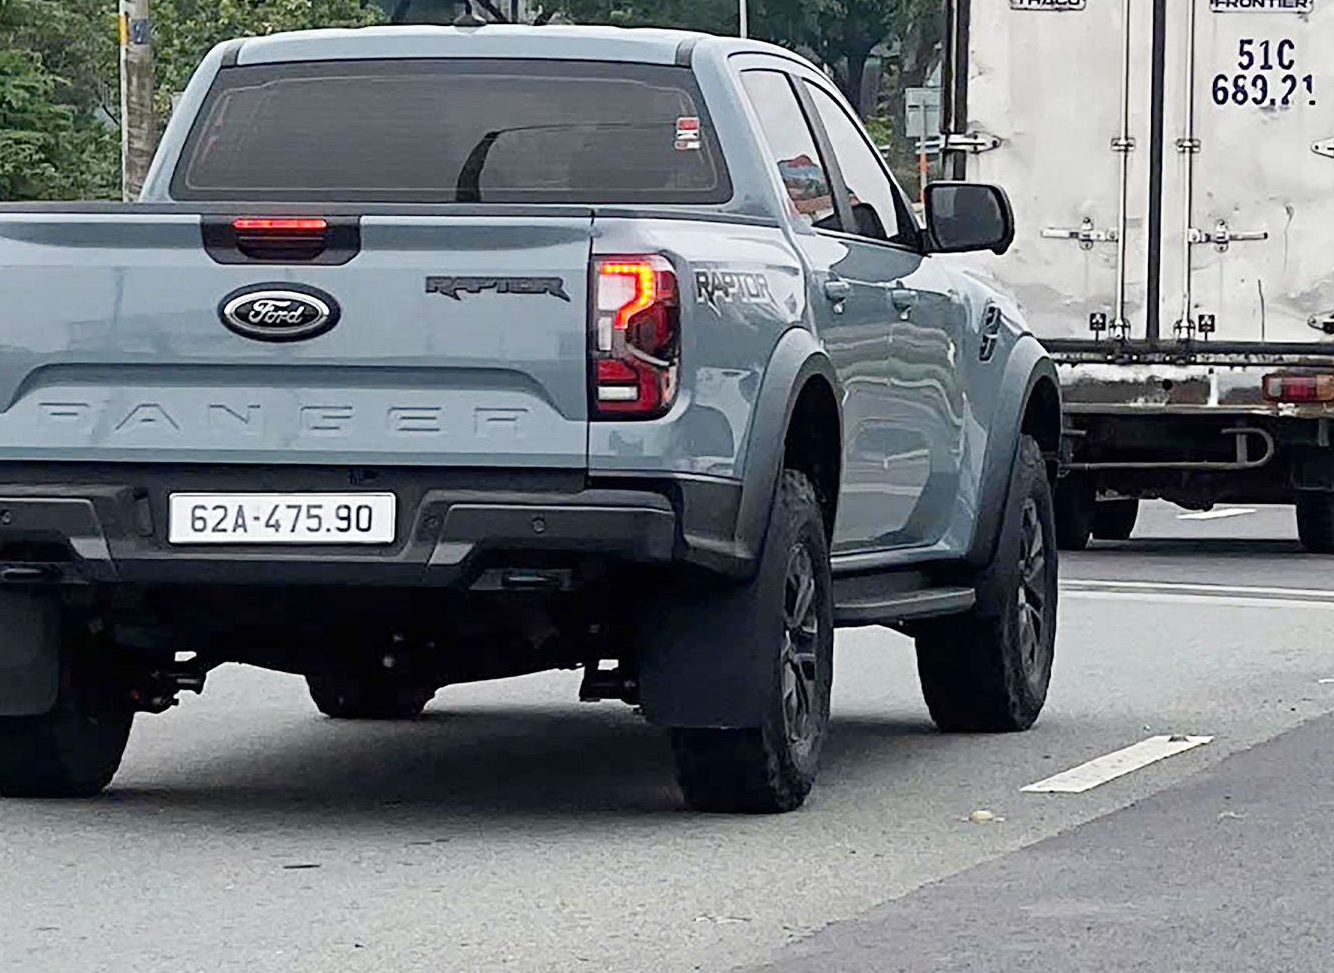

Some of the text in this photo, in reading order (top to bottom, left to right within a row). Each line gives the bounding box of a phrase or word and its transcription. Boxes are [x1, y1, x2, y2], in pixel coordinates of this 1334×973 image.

[1238, 38, 1295, 70] 51C
[1212, 73, 1316, 106] 689.21
[425, 276, 571, 302] RAPTOR
[693, 269, 778, 316] RAPTOR
[248, 299, 305, 324] Ford
[39, 402, 529, 436] RANGER
[190, 504, 373, 534] 62A-475.90
